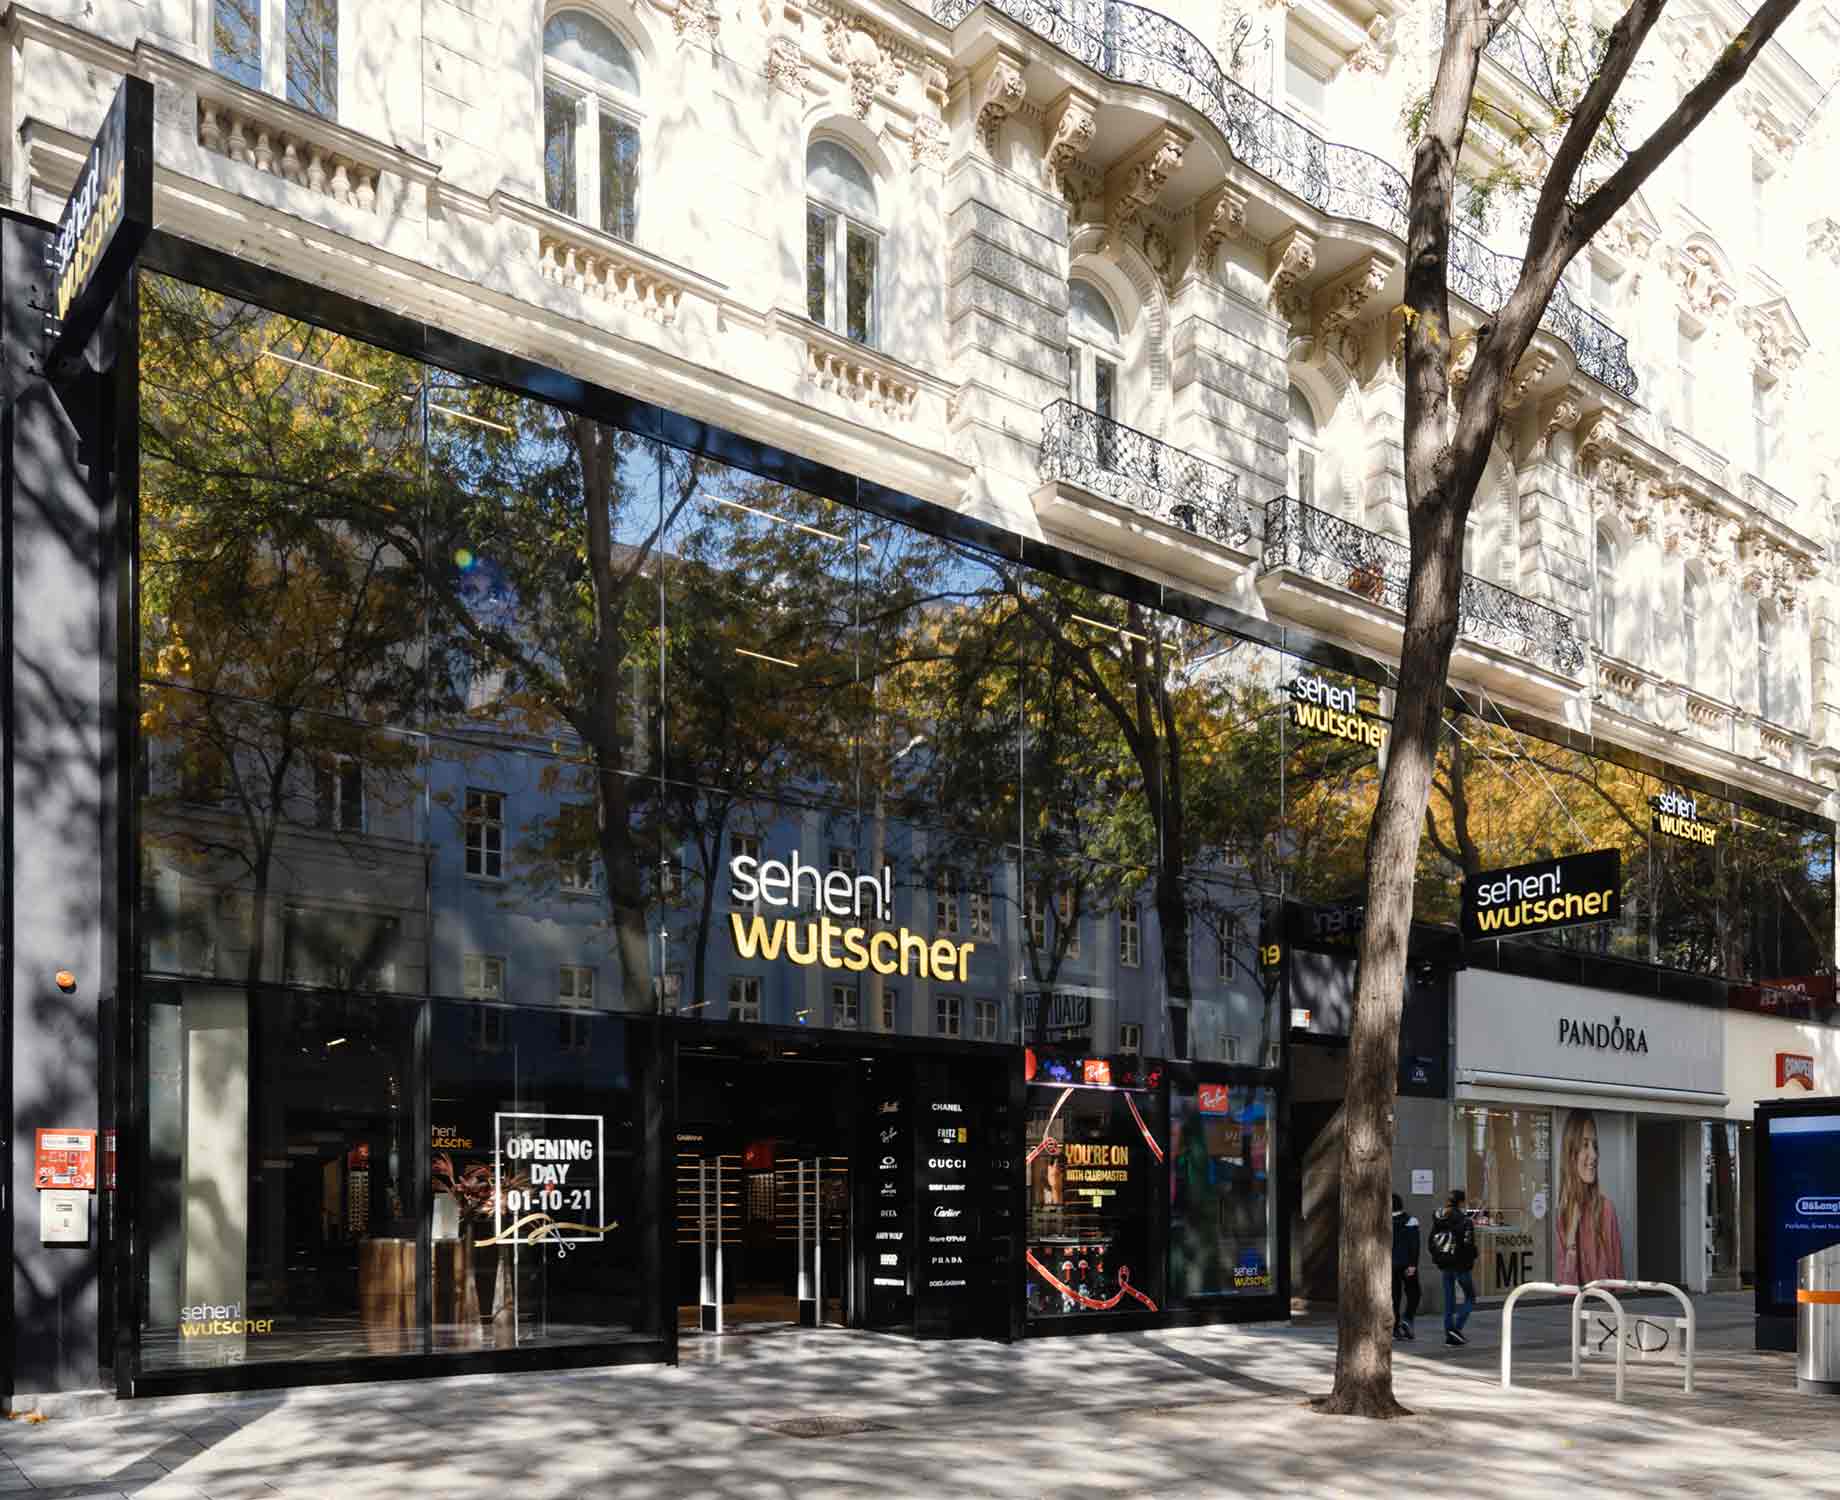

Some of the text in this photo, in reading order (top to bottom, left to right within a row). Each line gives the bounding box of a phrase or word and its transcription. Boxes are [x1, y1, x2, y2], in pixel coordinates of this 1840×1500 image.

[57, 147, 99, 275] sehen!
[58, 159, 124, 321] wutscher
[1295, 675, 1356, 714] sehen!
[1295, 702, 1388, 752] wutscher
[1659, 791, 1697, 820] sehen!
[1659, 814, 1717, 846] wutscher
[731, 849, 892, 921] sehen!
[1477, 865, 1561, 906] sehen!
[1477, 889, 1613, 931] wutscher
[729, 912, 976, 983] wutscher
[1559, 1017, 1648, 1054] PANDORA
[931, 1103, 963, 1113] CHANEL
[431, 1124, 457, 1137] hen!
[937, 1127, 957, 1139] FRITZ
[506, 1138, 593, 1161] OPENING
[1065, 1143, 1129, 1166] YOU'RE ON
[530, 1163, 570, 1185] DAY
[928, 1158, 967, 1169] GUCCI
[1084, 1169, 1128, 1182] CLUBMASTER
[507, 1189, 592, 1211] 01-10-21
[933, 1205, 961, 1218] Cartier
[931, 1256, 963, 1264] PRADA
[1495, 1250, 1534, 1289] ME
[181, 1301, 241, 1320] sehen!
[180, 1319, 274, 1336] wutscher
